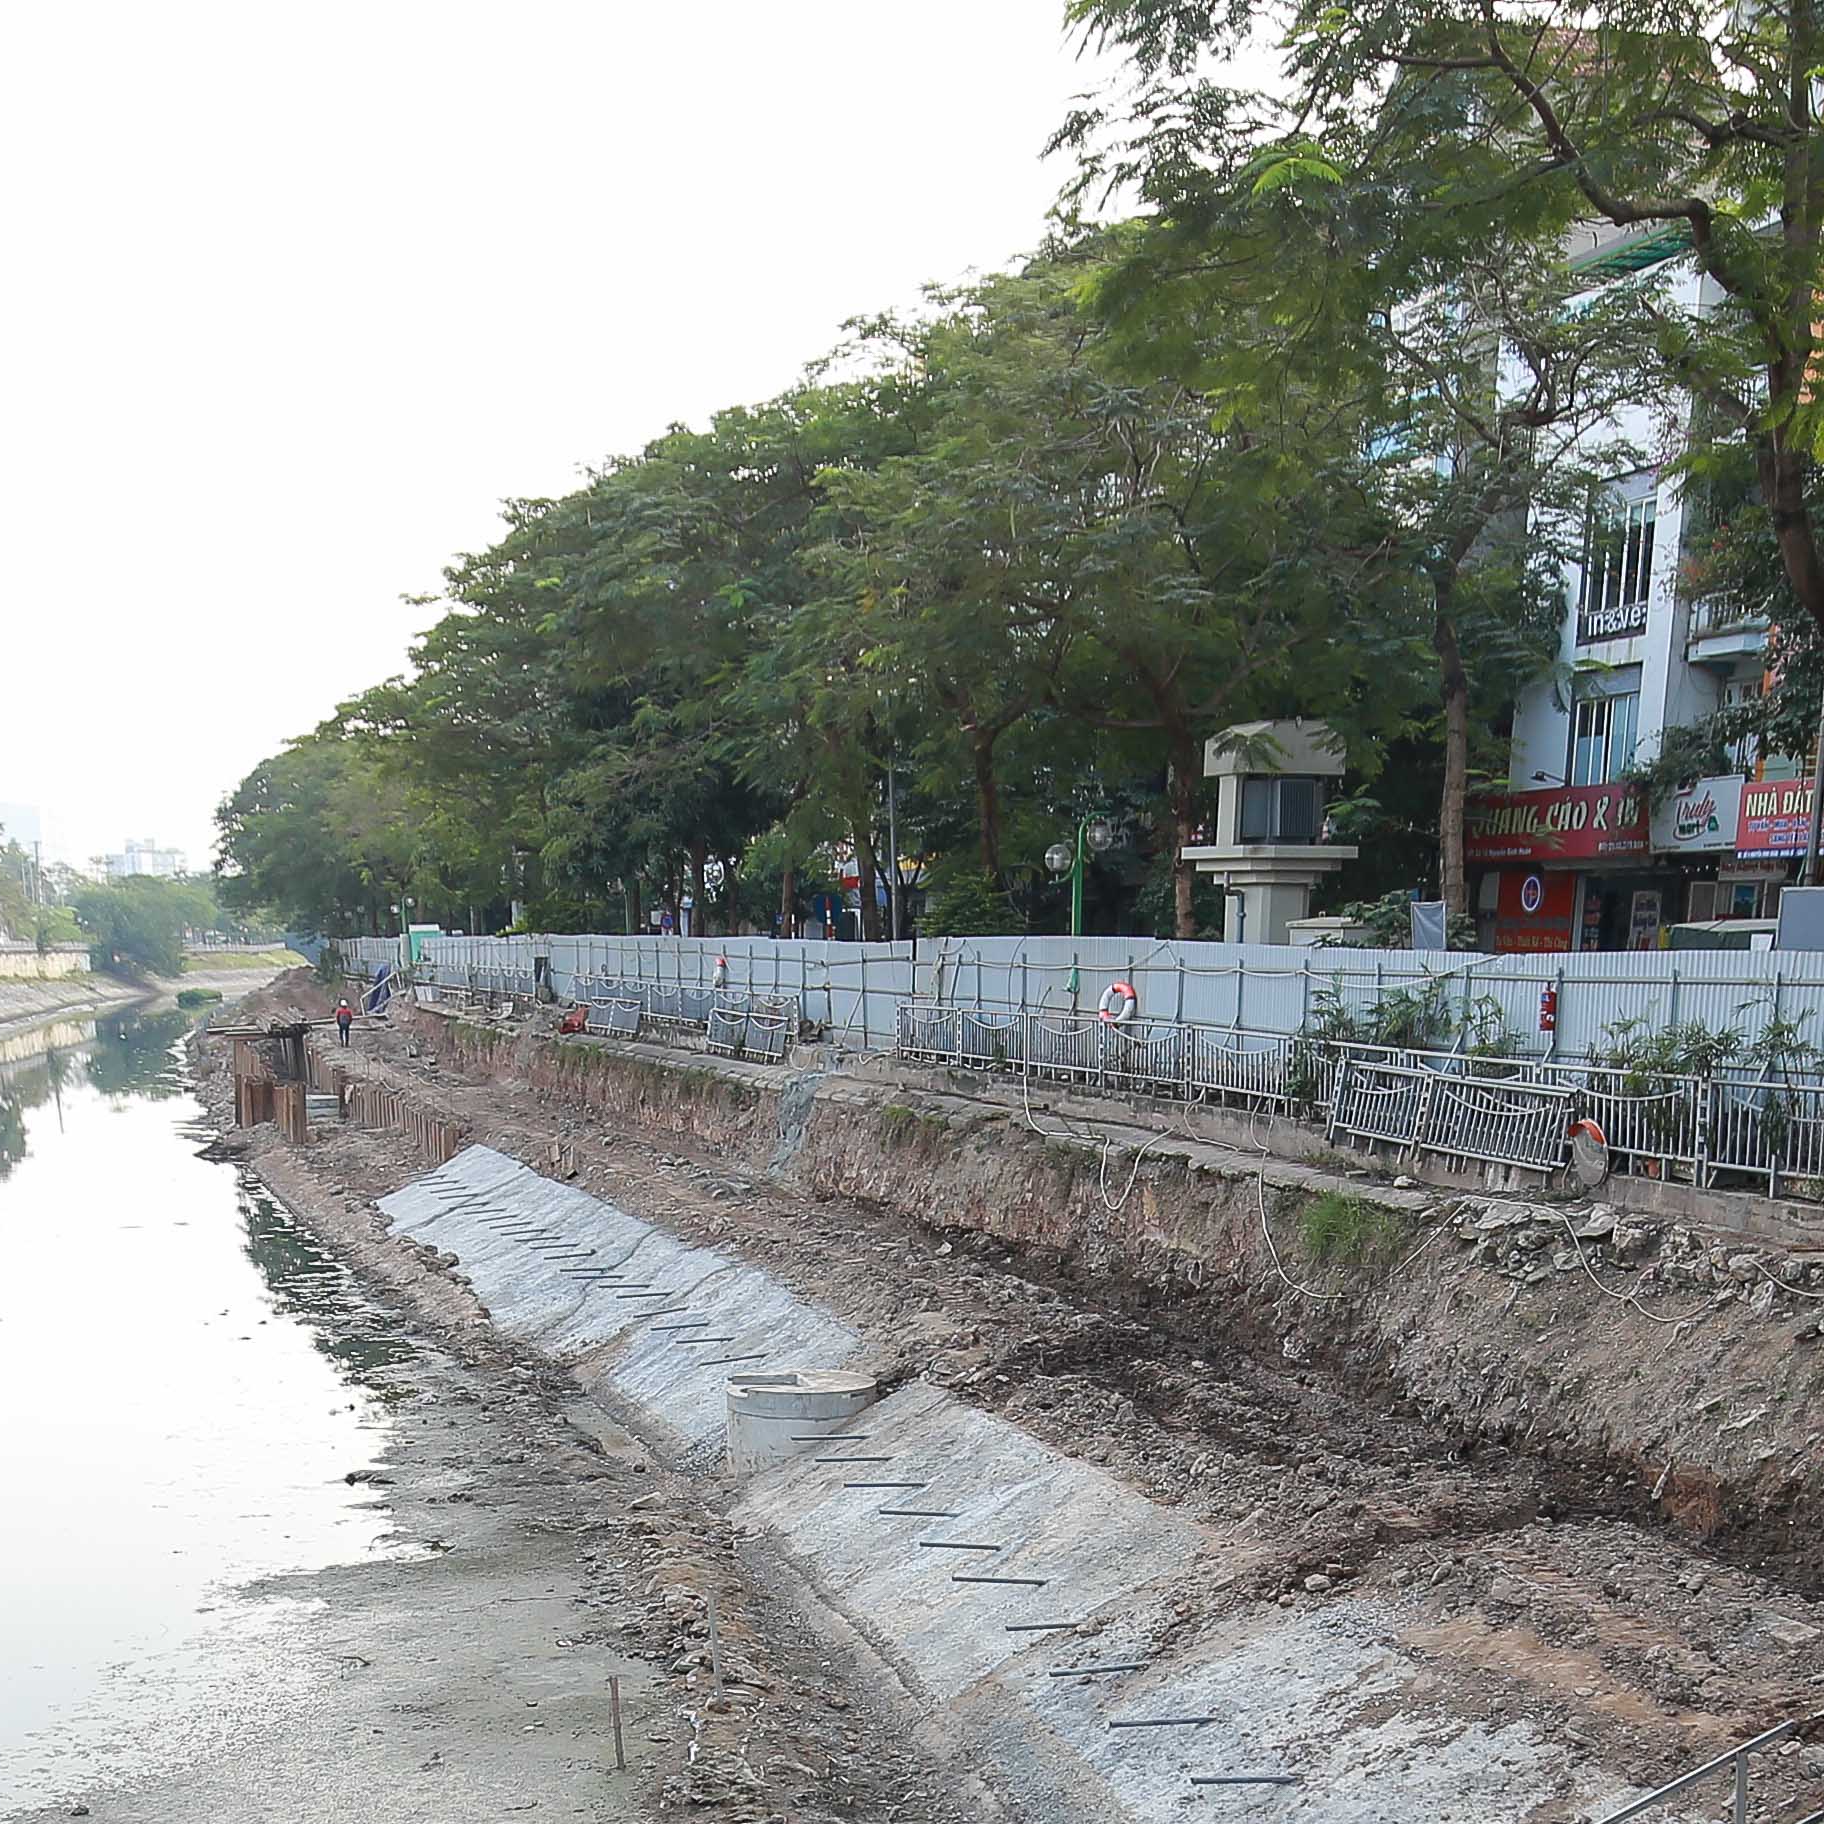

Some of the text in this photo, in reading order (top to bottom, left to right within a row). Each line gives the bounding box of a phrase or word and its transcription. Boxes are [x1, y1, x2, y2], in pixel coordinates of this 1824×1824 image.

[1546, 796, 1588, 832] CÁO
[1593, 796, 1609, 831] &
[1745, 787, 1778, 818] NHÀ
